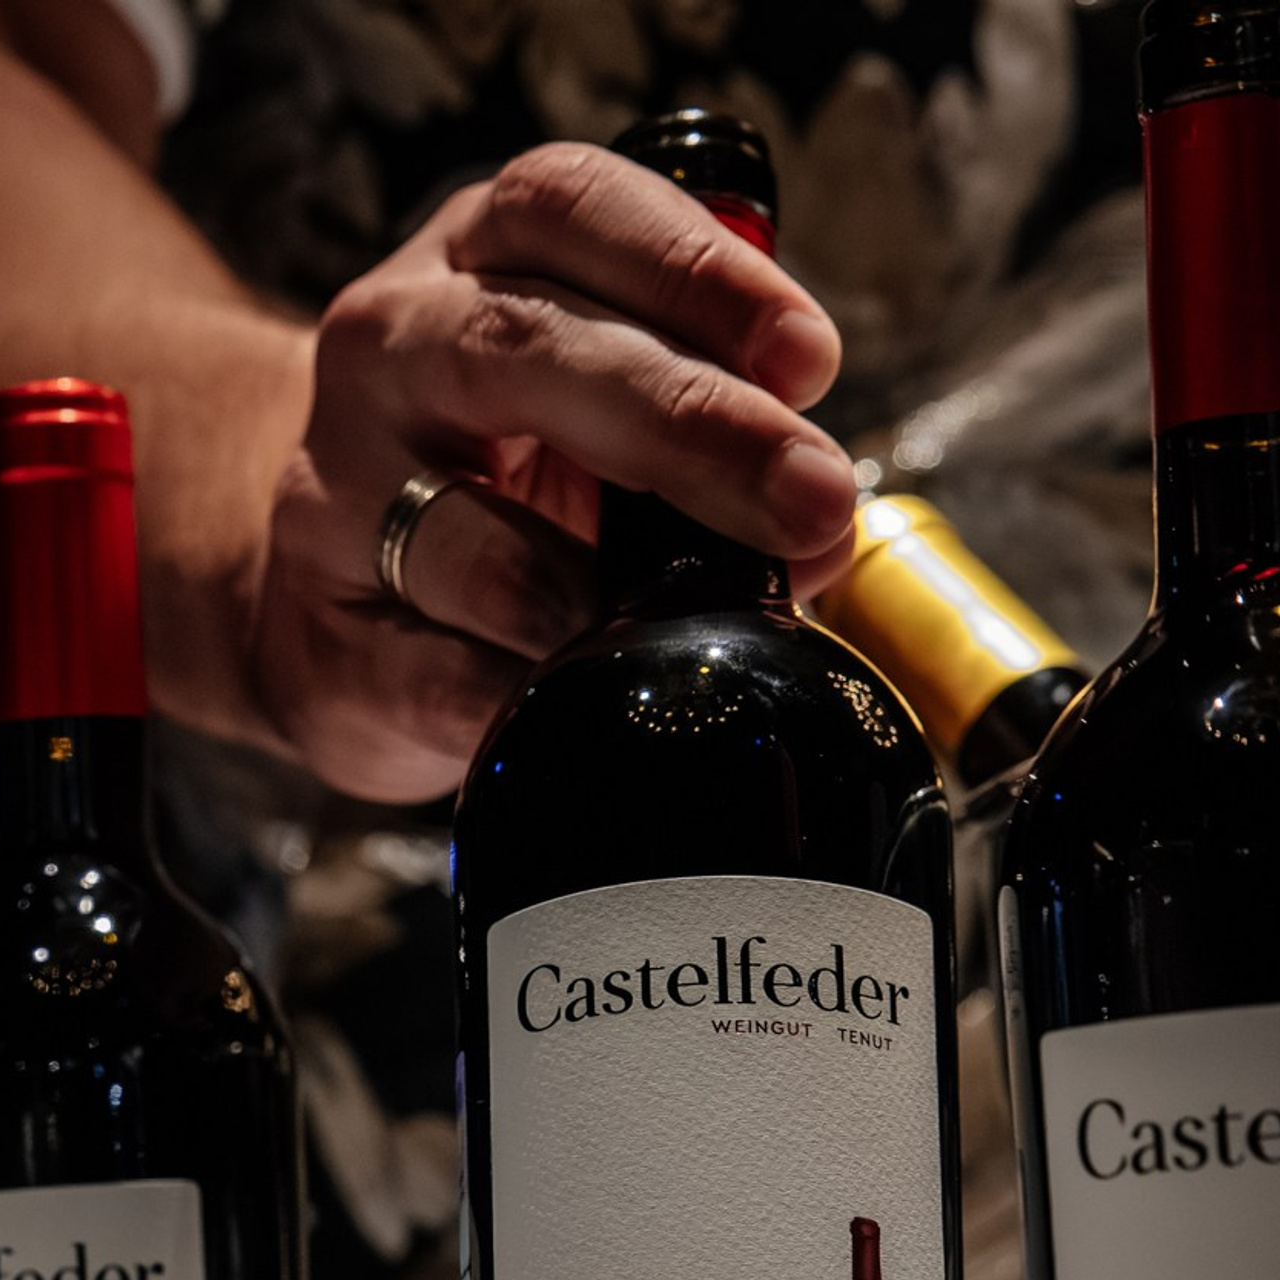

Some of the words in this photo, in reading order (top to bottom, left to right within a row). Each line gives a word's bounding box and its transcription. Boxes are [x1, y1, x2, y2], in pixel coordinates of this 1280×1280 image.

[517, 935, 910, 1033] Castelfeder
[711, 1019, 813, 1038] WEINGUT
[837, 1027, 893, 1051] TENUT
[1077, 1097, 1280, 1181] Caste
